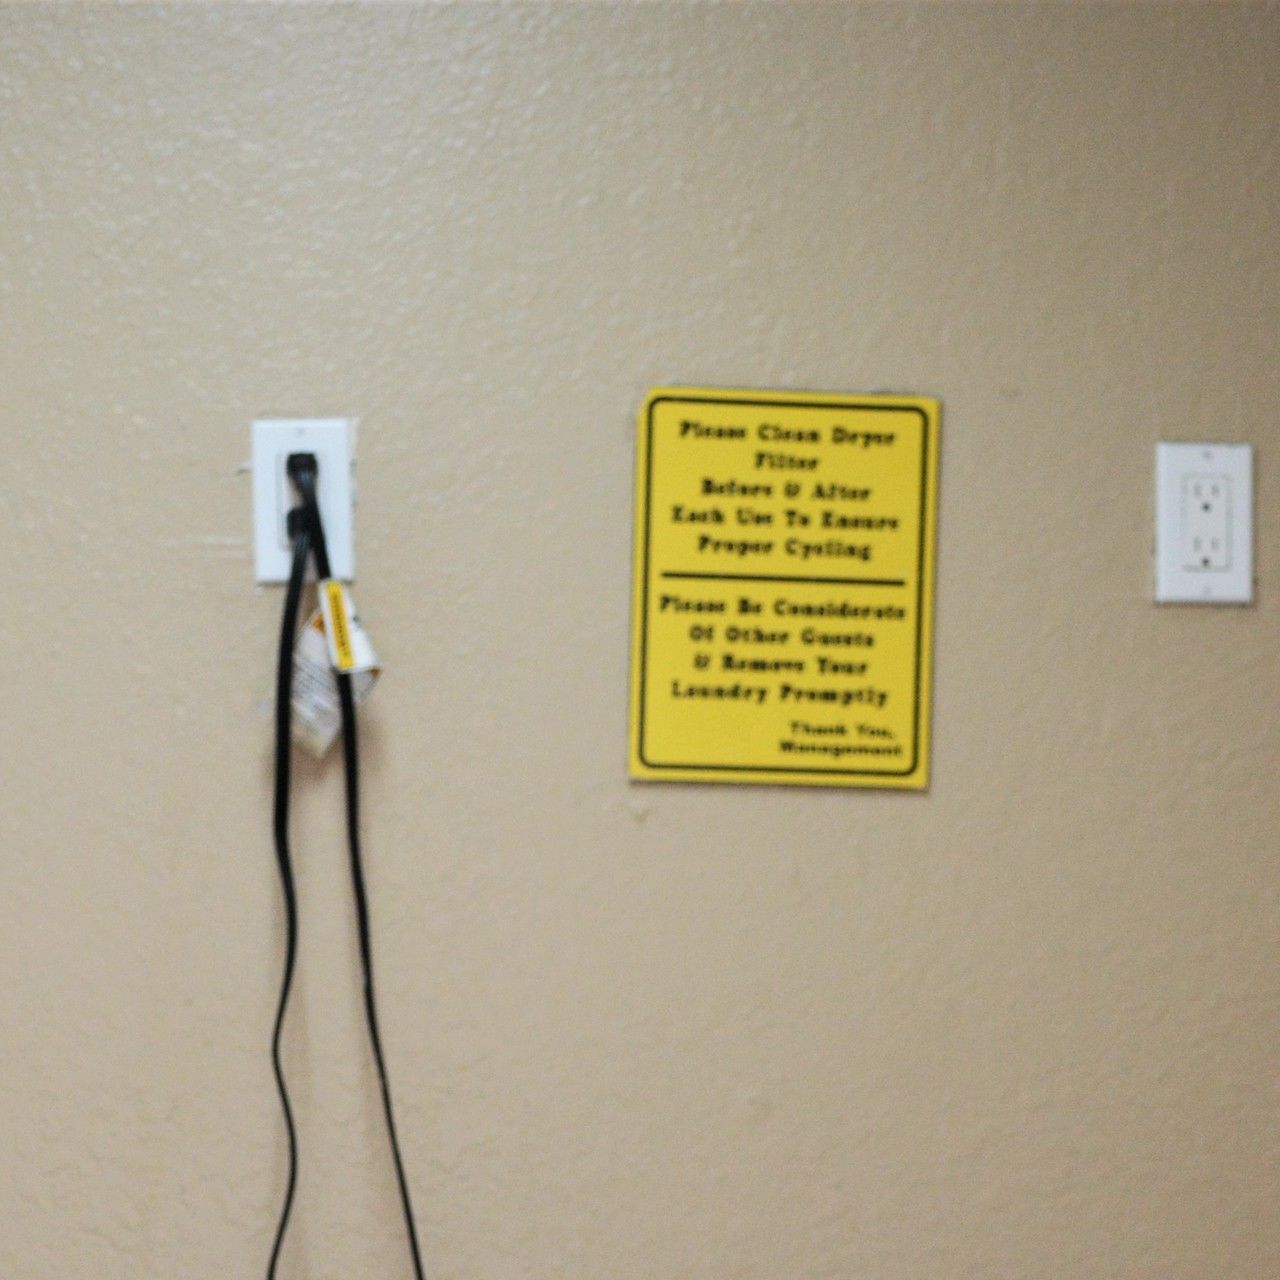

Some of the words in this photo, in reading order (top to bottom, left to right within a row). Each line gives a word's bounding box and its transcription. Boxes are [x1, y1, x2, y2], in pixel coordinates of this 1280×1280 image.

[680, 420, 746, 439] Please
[758, 423, 820, 443] Clean
[832, 426, 895, 448] Dryer
[755, 452, 818, 470] Filter
[702, 478, 772, 496] Before
[784, 482, 800, 498] &
[813, 483, 871, 500] After
[672, 506, 724, 523] Each
[737, 508, 773, 525] Use
[786, 510, 810, 527] To
[822, 512, 899, 530] Ensure
[699, 536, 772, 556] Proper
[785, 539, 871, 561] Cycling
[660, 596, 725, 613] Please
[738, 598, 762, 614] Be
[774, 600, 905, 620] Considerate
[689, 625, 714, 642] Of
[725, 626, 789, 644] Other
[801, 628, 874, 648] Guests
[694, 655, 710, 672] &
[722, 655, 804, 673] Remove
[818, 656, 868, 674] Your
[671, 681, 767, 703] Laundry
[780, 684, 887, 707] Promptly
[790, 721, 848, 736] Thank
[780, 741, 902, 759] Management
